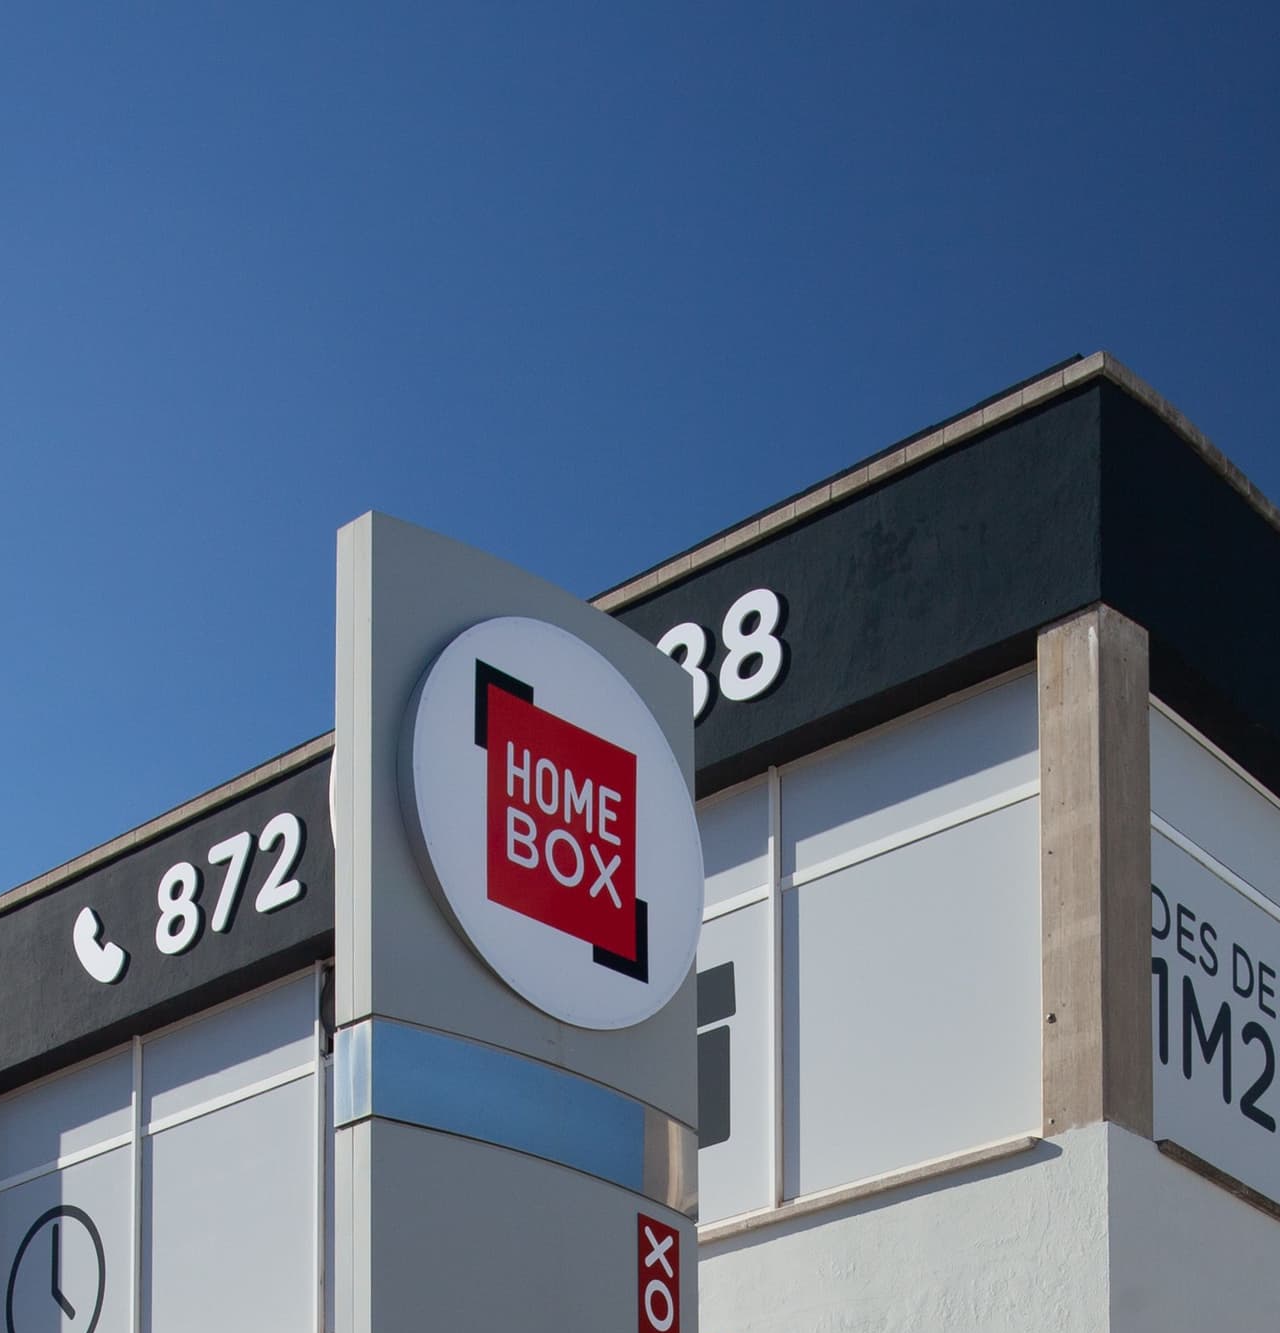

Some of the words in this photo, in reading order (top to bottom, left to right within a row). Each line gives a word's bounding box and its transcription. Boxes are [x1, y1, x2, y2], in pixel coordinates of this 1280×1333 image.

[506, 740, 622, 846] HOME
[506, 807, 622, 910] BOX
[154, 812, 303, 956] 872
[1151, 883, 1218, 977] DES
[1233, 942, 1277, 1019] DE
[1151, 956, 1277, 1134] 1M2
